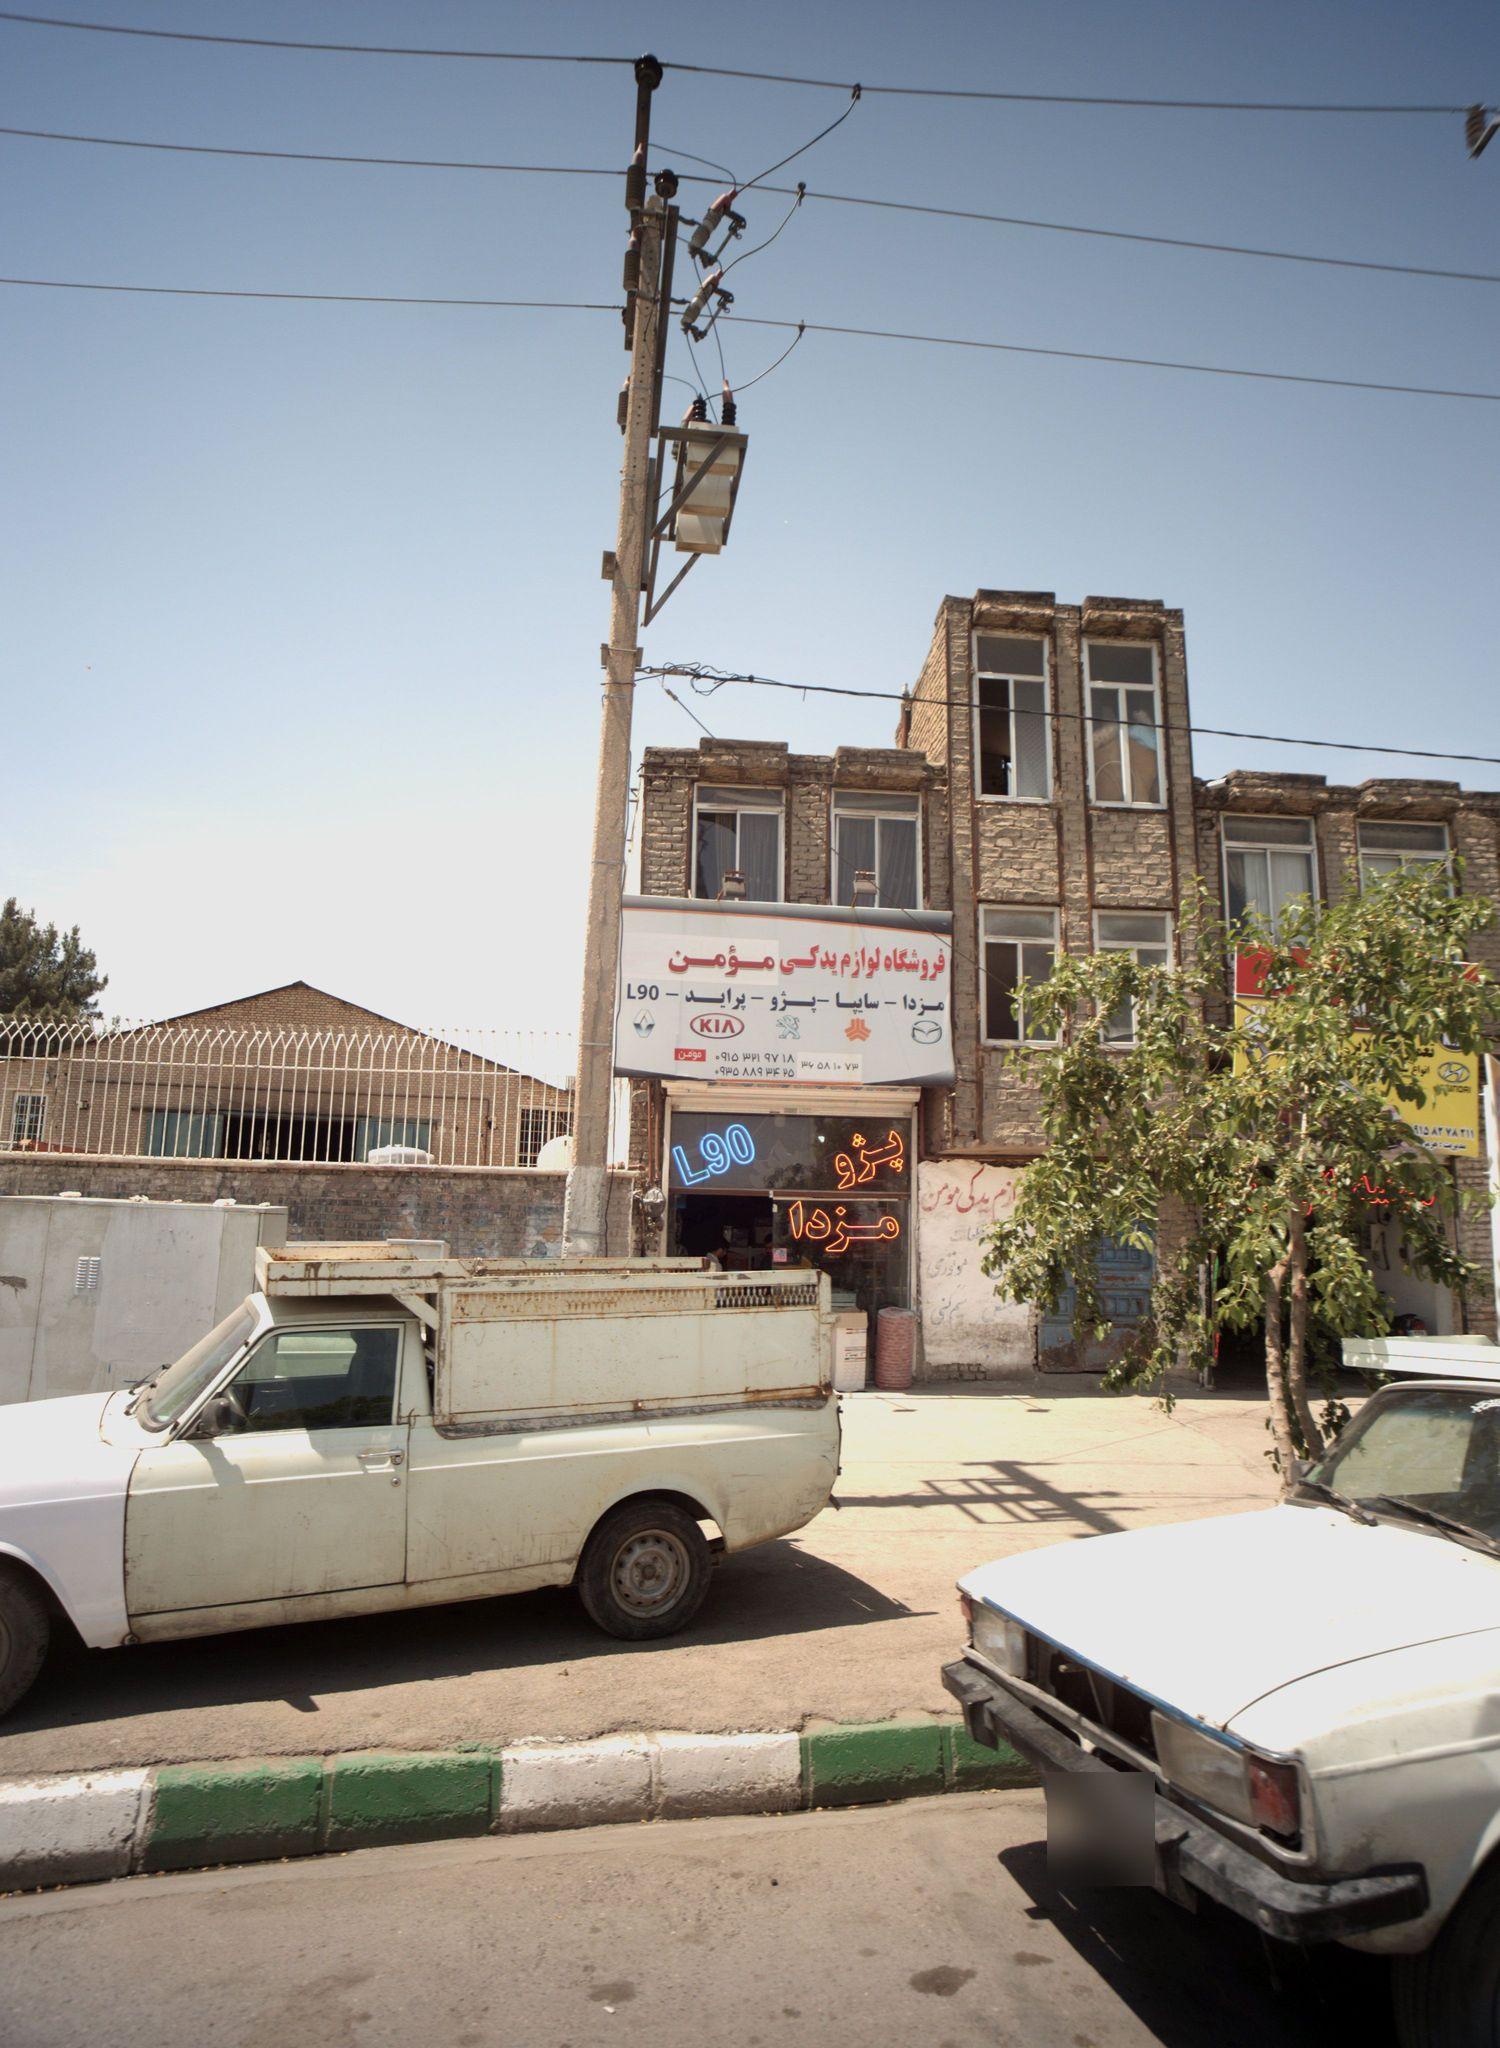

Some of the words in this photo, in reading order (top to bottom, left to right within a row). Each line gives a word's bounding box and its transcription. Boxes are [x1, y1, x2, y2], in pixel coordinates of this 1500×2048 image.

[779, 945, 838, 976] یدکی
[840, 946, 881, 979] لوازم
[884, 946, 945, 981] فروشگاه
[626, 983, 660, 1001] L90
[684, 987, 747, 1011] پراید
[769, 990, 817, 1013] پژو
[834, 991, 880, 1015] سایپا
[902, 993, 945, 1015] مزدا
[699, 1018, 736, 1033] KIA
[671, 1123, 756, 1187] L90
[834, 1129, 904, 1190] پژو
[788, 1200, 901, 1252] مزدا
